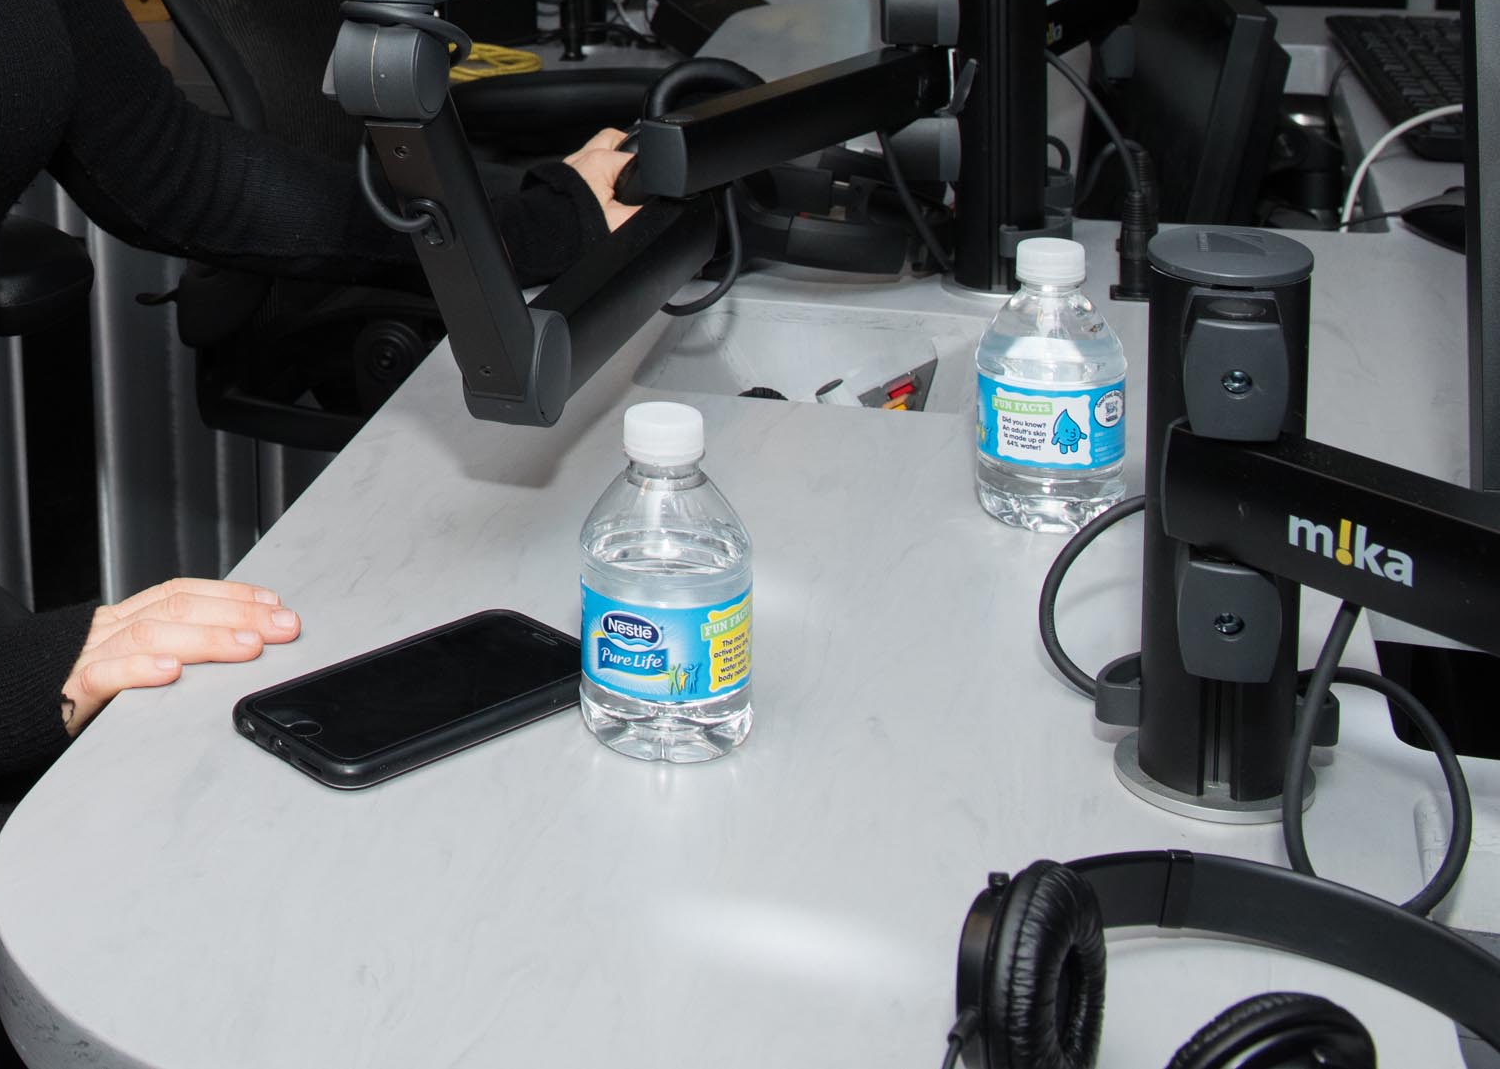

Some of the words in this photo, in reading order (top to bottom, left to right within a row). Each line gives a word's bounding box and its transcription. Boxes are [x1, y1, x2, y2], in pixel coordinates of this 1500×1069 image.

[995, 398, 1012, 411] FUN
[1014, 401, 1051, 413] FACTS
[1025, 421, 1046, 429] know?
[1011, 427, 1031, 435] adult's
[1009, 434, 1026, 442] made
[704, 621, 728, 637] FUN
[722, 638, 733, 648] The
[734, 632, 745, 642] more
[713, 647, 732, 658] active
[601, 647, 632, 666] Pure
[633, 653, 664, 670] Life
[723, 655, 733, 664] the
[720, 663, 737, 673] water
[718, 672, 733, 682] body
